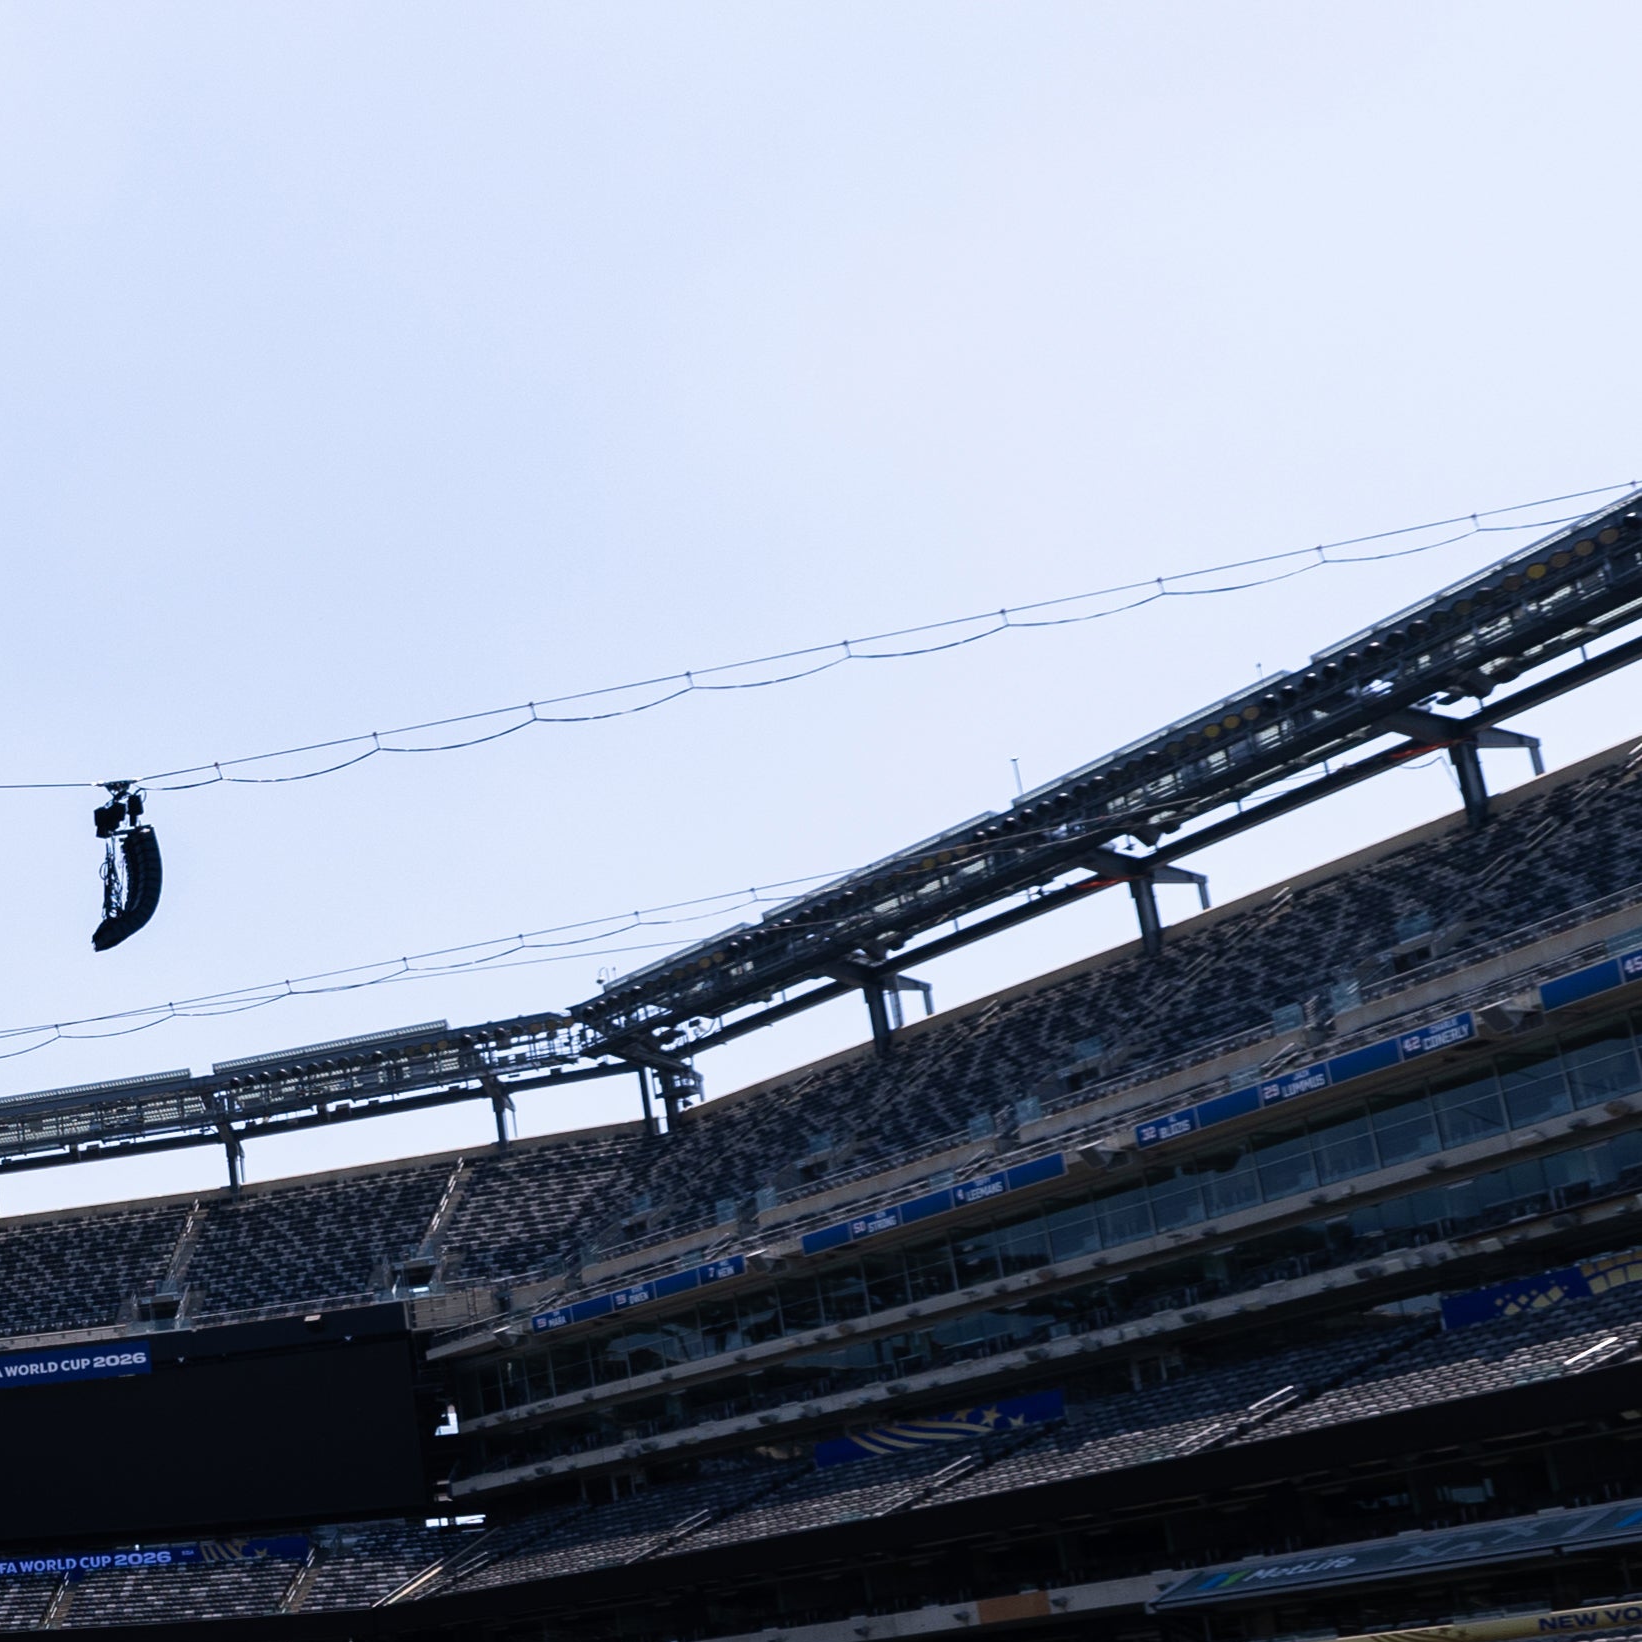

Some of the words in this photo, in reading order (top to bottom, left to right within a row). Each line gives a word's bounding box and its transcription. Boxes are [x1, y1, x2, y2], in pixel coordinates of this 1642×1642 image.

[1403, 1036, 1420, 1051] 42
[4, 1362, 58, 1377] WORLD
[60, 1358, 91, 1371] CUP
[93, 1352, 147, 1368] 2026
[19, 1558, 77, 1573] WORLD
[79, 1555, 112, 1569] CUP
[114, 1551, 172, 1566] 2026
[1538, 1611, 1597, 1631] NEW
